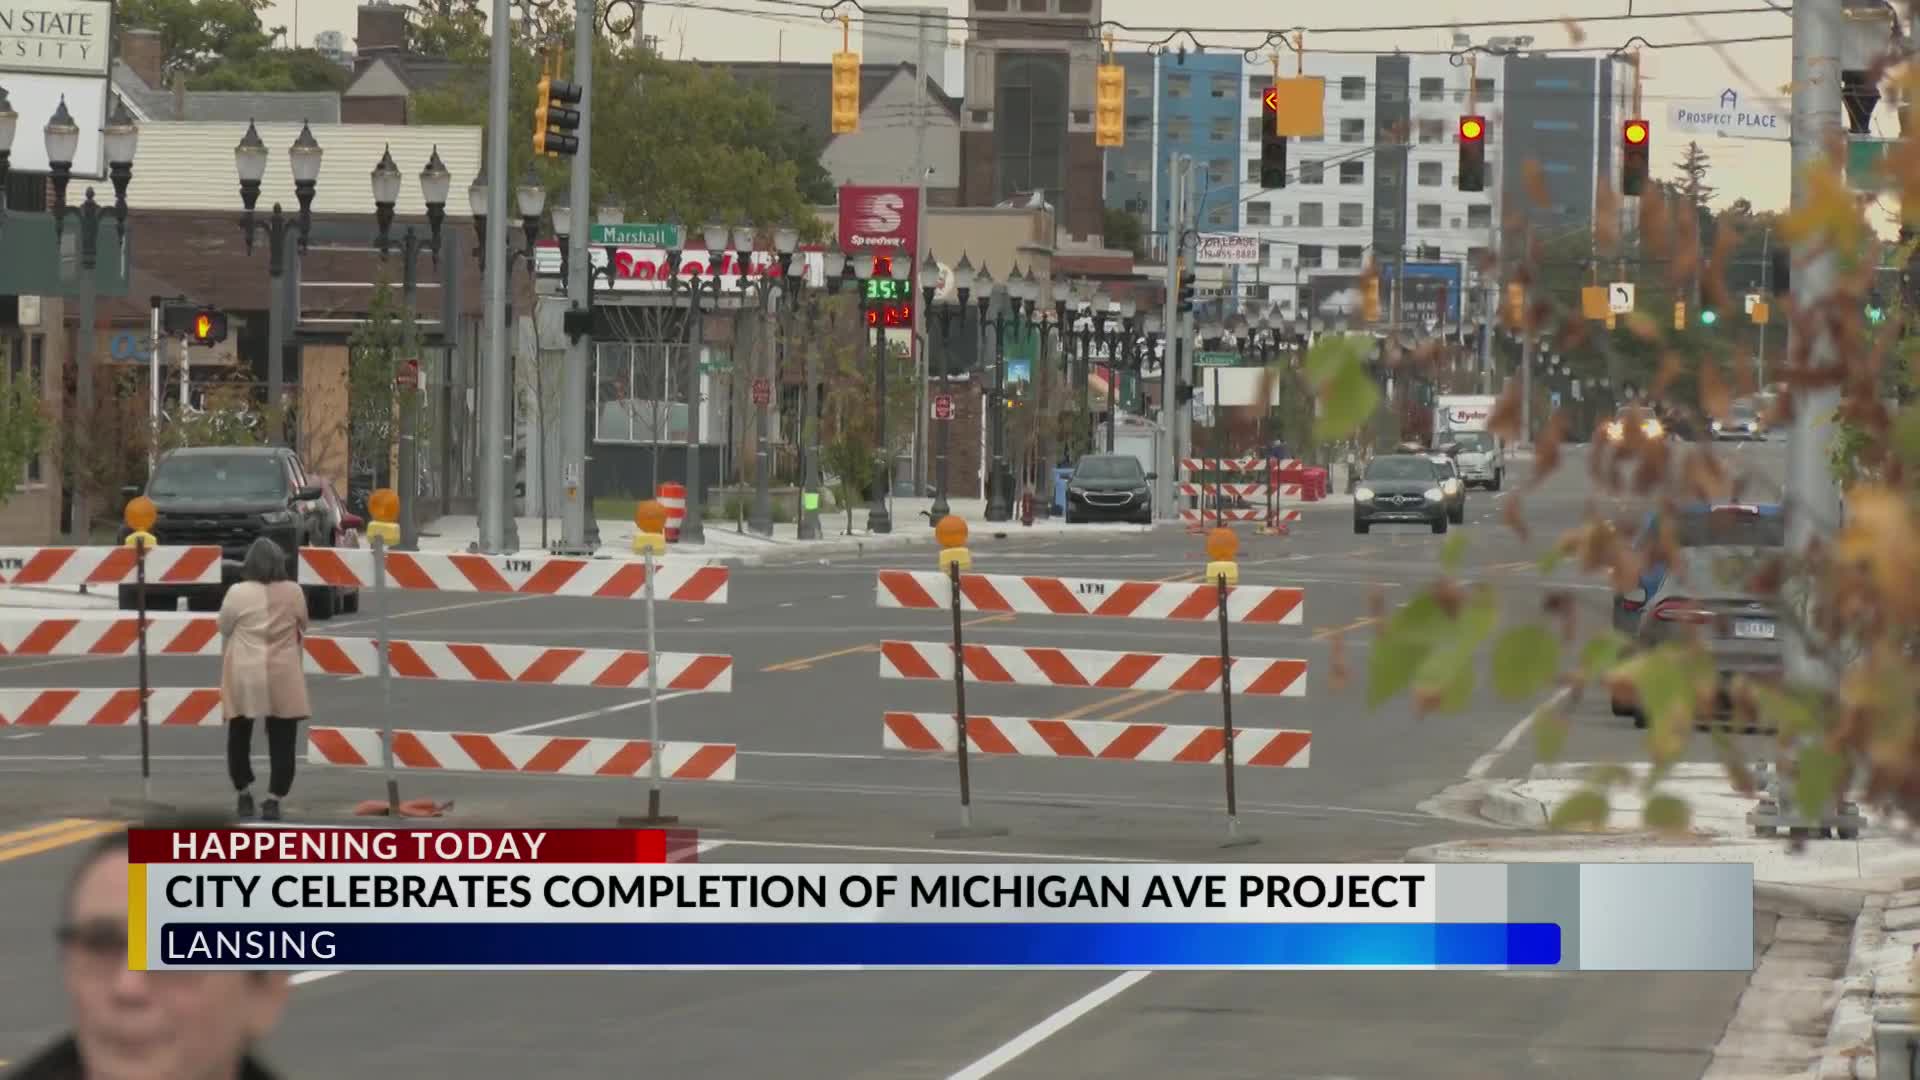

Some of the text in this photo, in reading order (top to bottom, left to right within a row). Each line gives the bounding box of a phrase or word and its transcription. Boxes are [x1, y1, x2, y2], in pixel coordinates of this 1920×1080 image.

[21, 9, 93, 36] STATE
[0, 40, 91, 60] SITY
[1678, 109, 1776, 128] PROSPECT PLACE
[603, 227, 665, 244] Marshall
[502, 559, 531, 572] ATM
[1076, 583, 1104, 595] ATM
